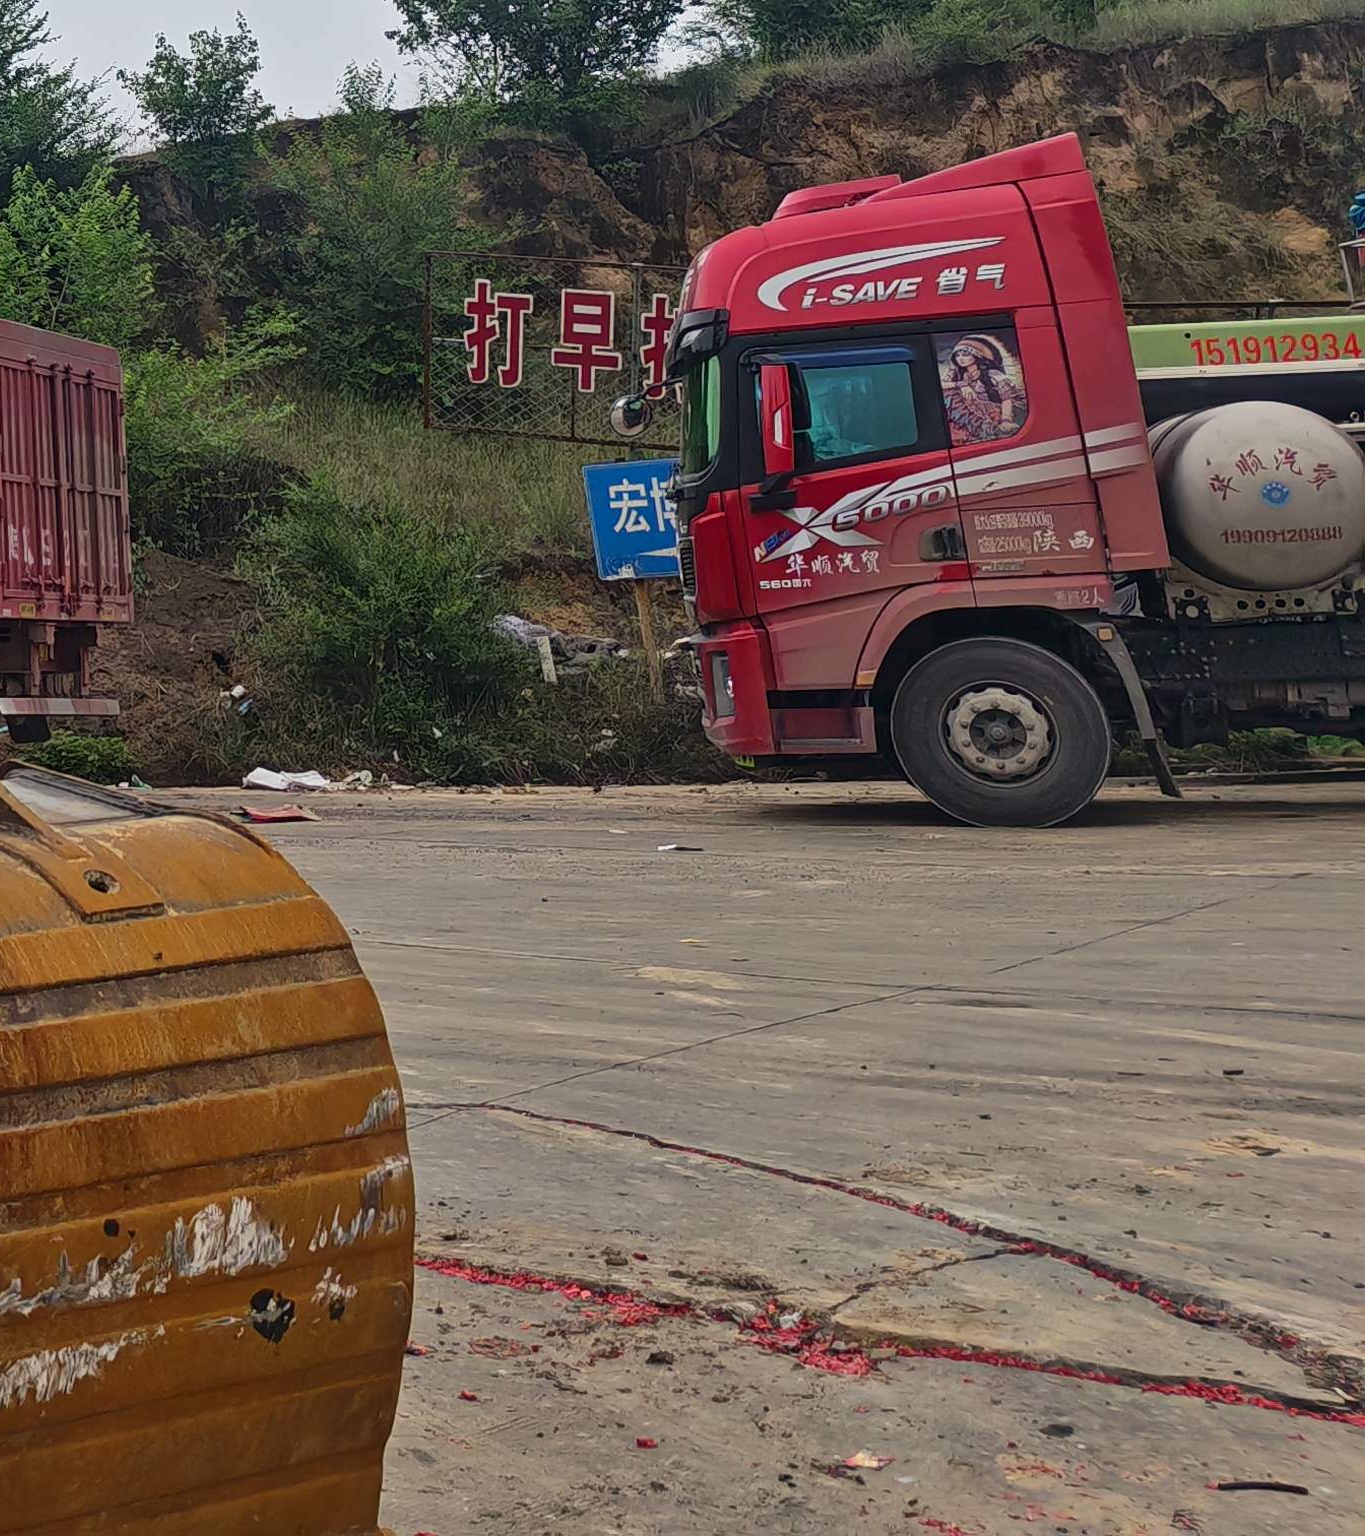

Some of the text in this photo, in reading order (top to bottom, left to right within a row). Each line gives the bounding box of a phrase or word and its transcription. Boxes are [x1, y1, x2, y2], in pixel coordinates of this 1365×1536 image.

[800, 263, 1005, 309] i-SAVE 省气
[1190, 330, 1362, 367] 151912934
[1033, 529, 1095, 552] 陕西
[786, 550, 880, 576] 华顺汽贸
